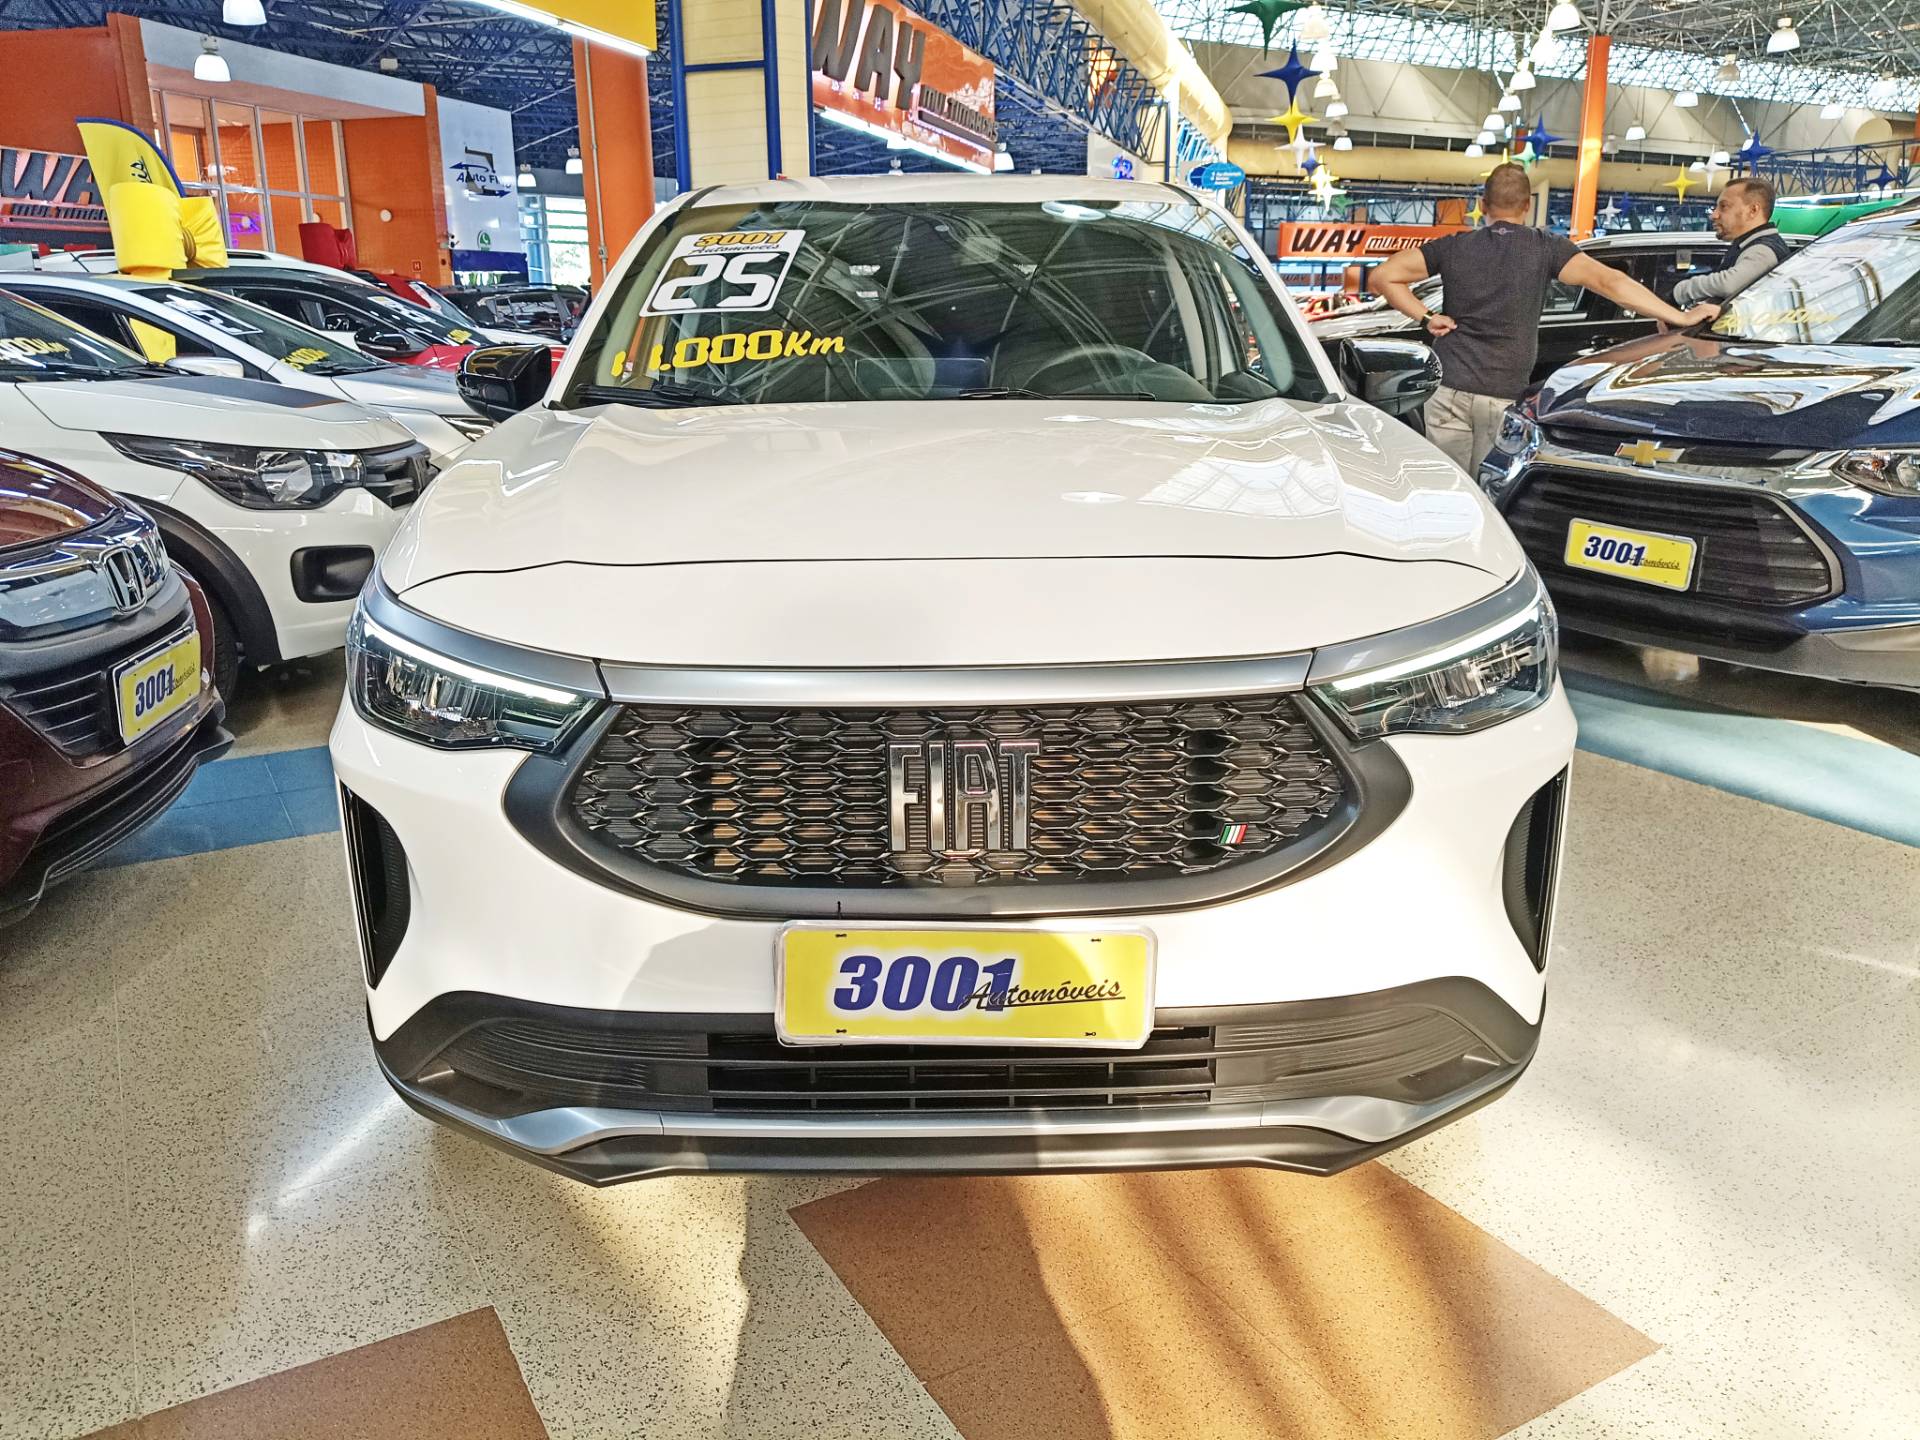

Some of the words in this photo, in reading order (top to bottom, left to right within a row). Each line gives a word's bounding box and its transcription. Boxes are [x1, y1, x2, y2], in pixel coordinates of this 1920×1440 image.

[811, 0, 926, 111] WAY
[694, 232, 787, 247] 3001
[1291, 228, 1366, 253] WAY
[651, 252, 780, 311] 25
[1584, 535, 1646, 566] 3001
[135, 663, 174, 717] 3001
[888, 739, 1042, 852] FIAT
[833, 955, 1017, 1012] 3001
[958, 979, 1123, 1011] Automóveis
